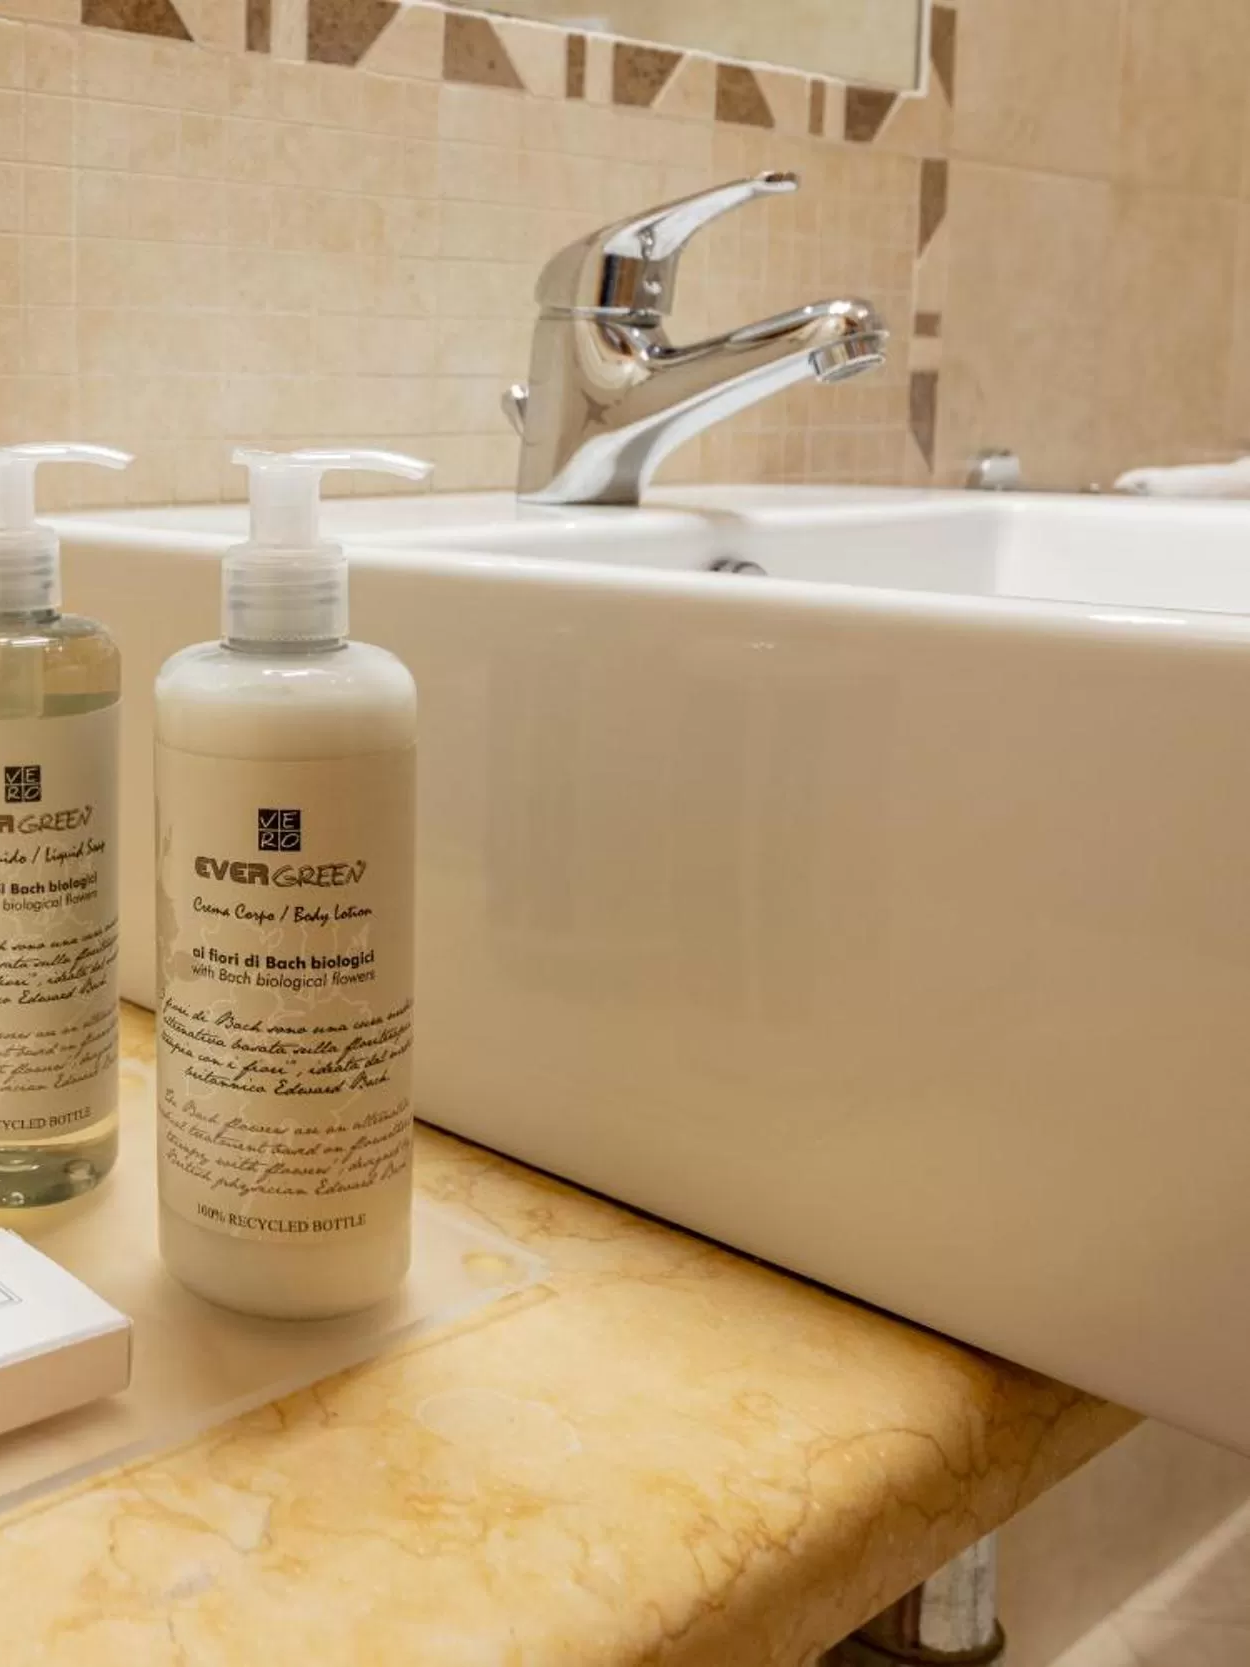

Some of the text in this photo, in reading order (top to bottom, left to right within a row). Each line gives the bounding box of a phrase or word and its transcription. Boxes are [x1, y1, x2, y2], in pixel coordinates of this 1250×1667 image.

[46, 842, 84, 868] Liquid
[11, 883, 45, 895] Bach
[49, 871, 98, 893] biologici
[3, 894, 63, 913] biological
[193, 896, 230, 918] Crema
[234, 903, 276, 925] Corpo
[294, 906, 331, 926] Body
[334, 904, 373, 920] Lotion
[192, 947, 375, 970] ai fiori di Bach biologici
[191, 963, 376, 991] with Bach biological flowers
[214, 1010, 264, 1033] Bach
[274, 1079, 346, 1096] Edward
[49, 1106, 92, 1127] BOTTLE
[197, 1203, 367, 1233] 100% RECYCLED BOTTLE
